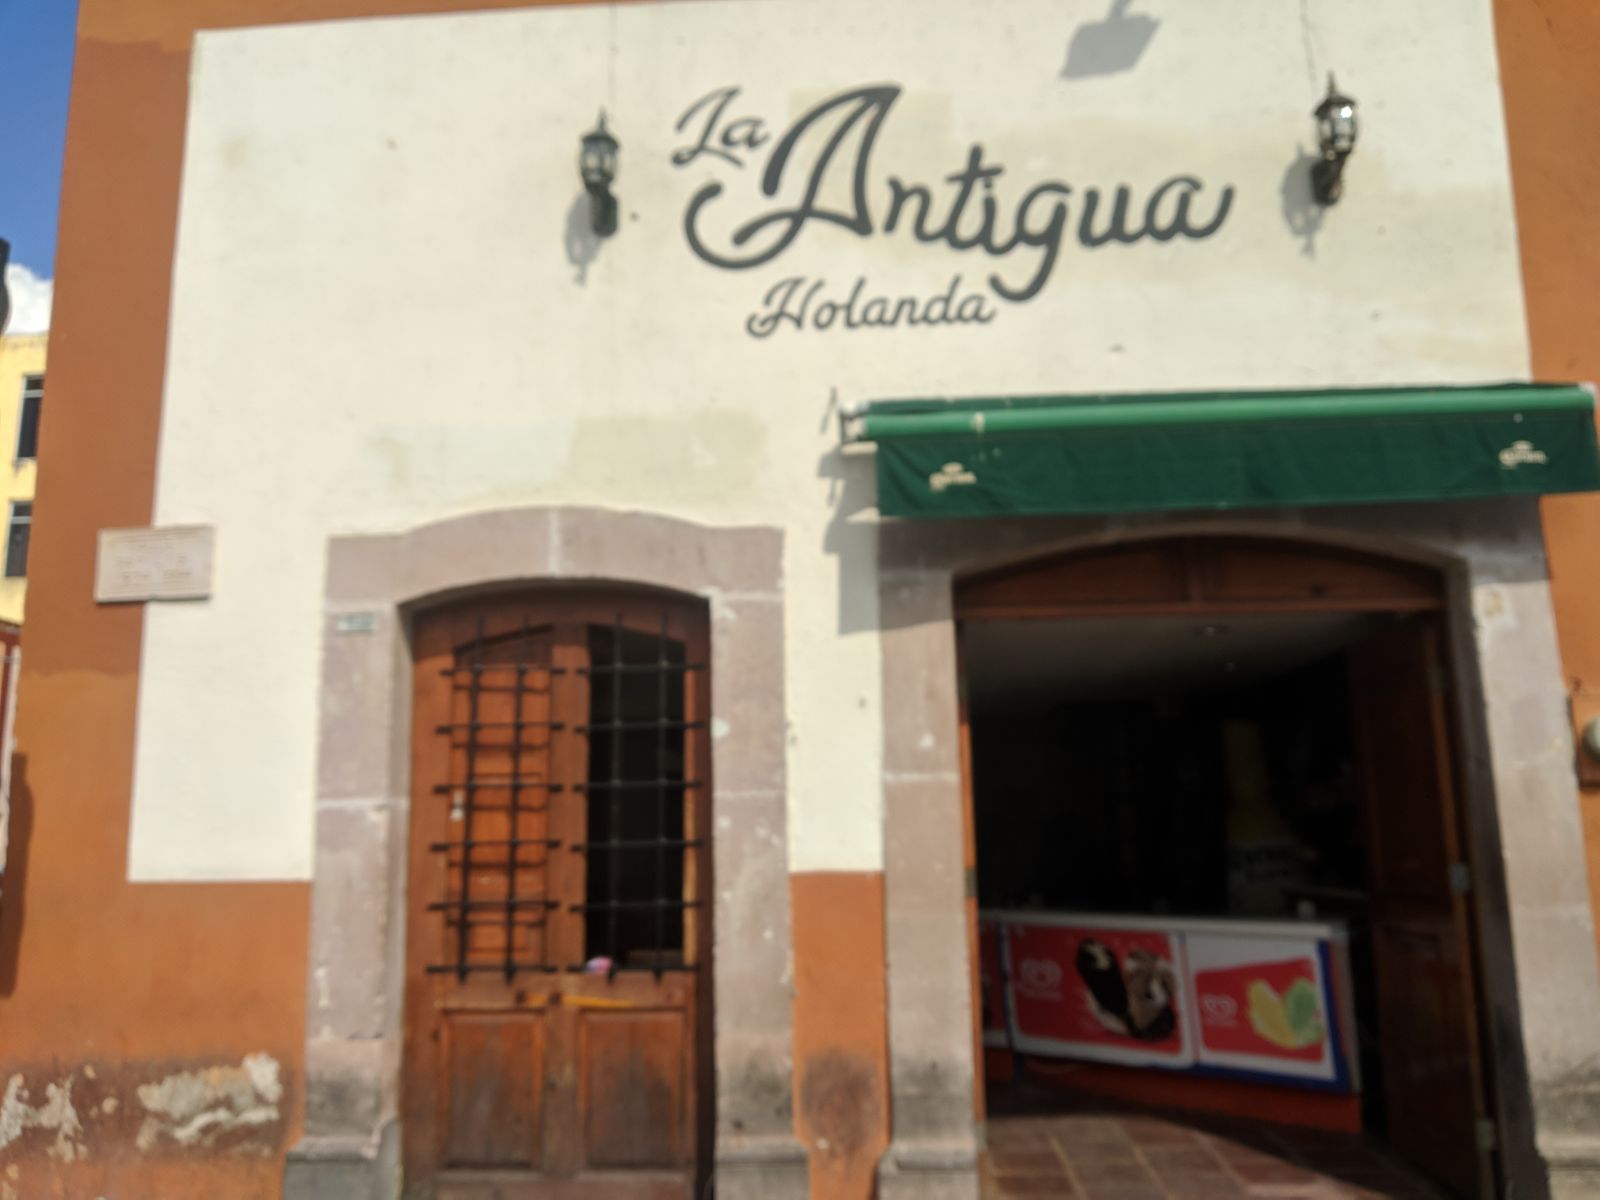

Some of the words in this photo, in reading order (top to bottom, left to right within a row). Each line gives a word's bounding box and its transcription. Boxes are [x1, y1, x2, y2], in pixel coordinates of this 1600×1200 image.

[671, 86, 769, 168] La
[685, 82, 1235, 302] Antigua
[746, 276, 998, 338] Holanda
